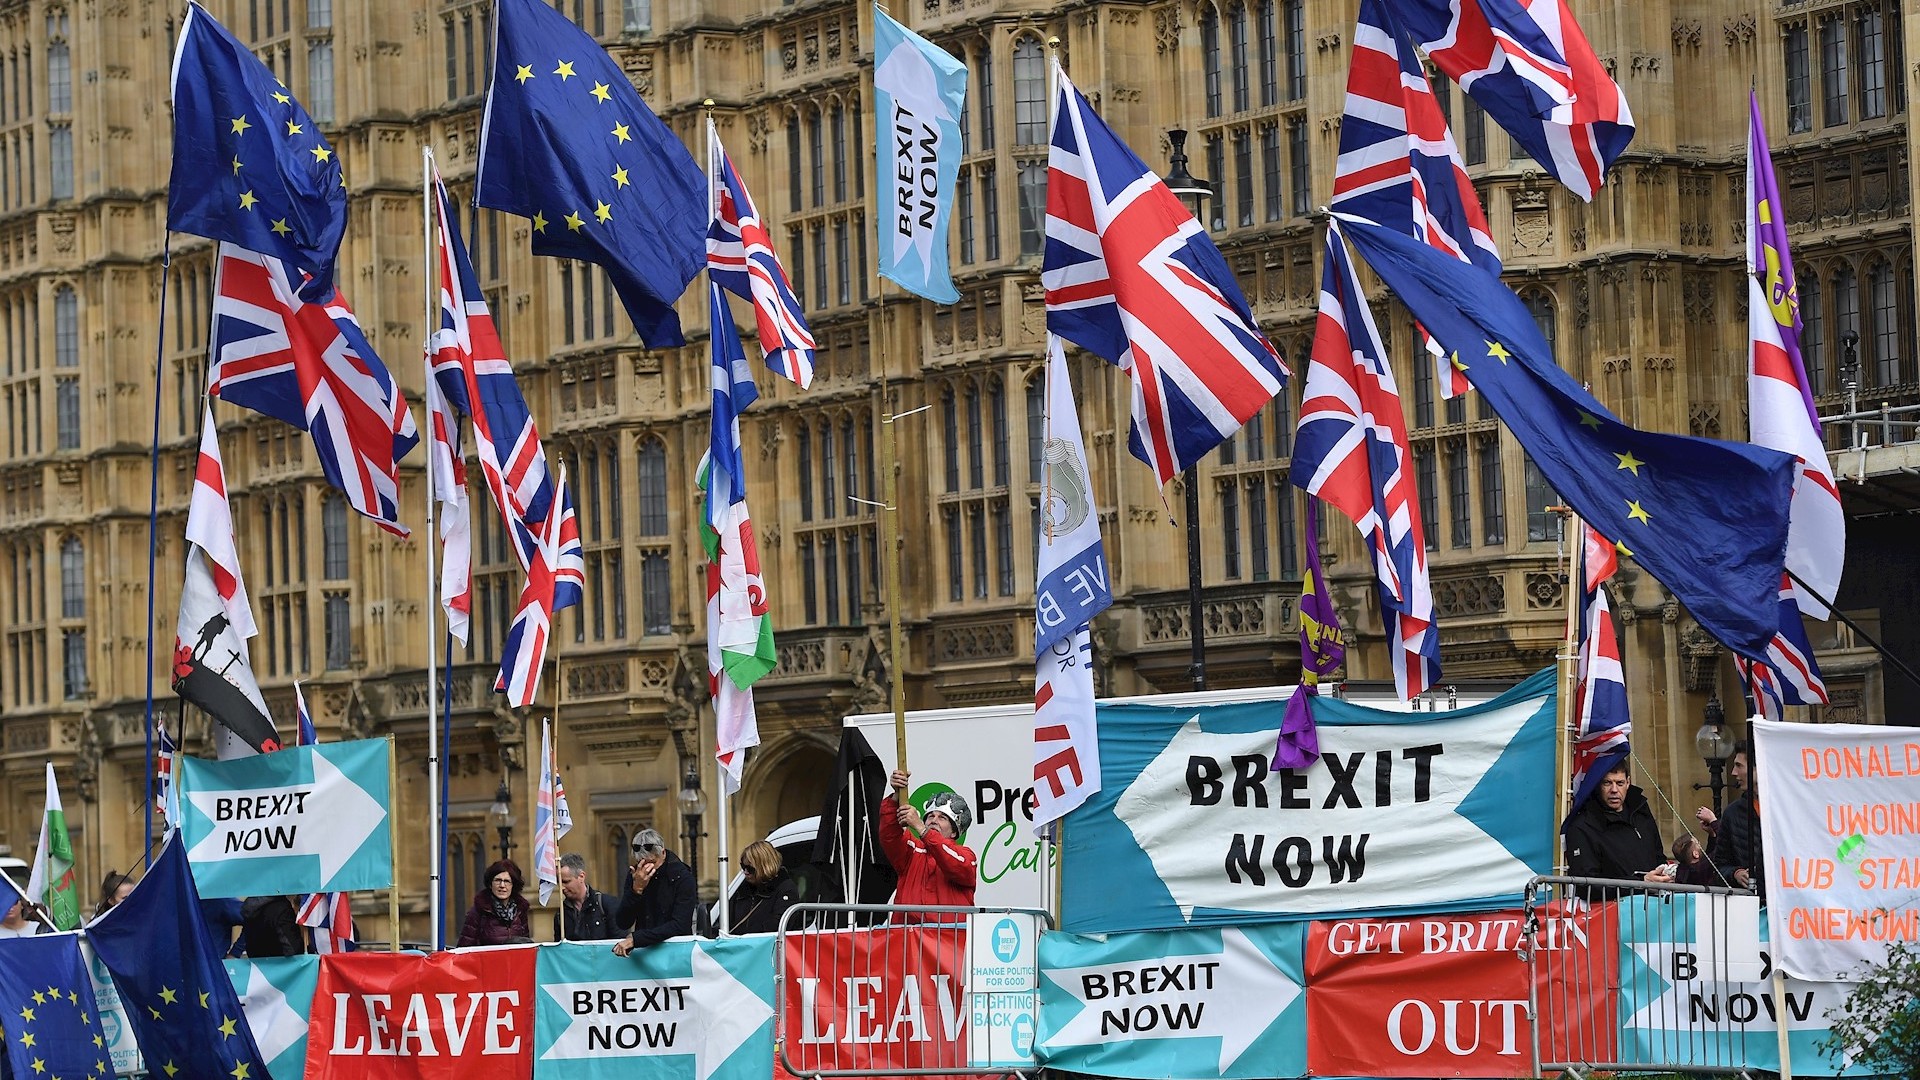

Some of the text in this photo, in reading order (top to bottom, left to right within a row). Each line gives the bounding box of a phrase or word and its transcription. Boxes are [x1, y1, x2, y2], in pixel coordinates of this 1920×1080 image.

[895, 98, 915, 238] BREXIT
[918, 122, 938, 230] NOW
[1185, 743, 1444, 810] BREXIT
[1802, 743, 1920, 779] DONALD
[216, 791, 312, 822] BREXIT
[224, 825, 297, 854] NOW
[1225, 833, 1371, 888] NOW
[1781, 857, 1834, 889] LUB
[1328, 916, 1592, 956] GET BRITAIN
[971, 966, 1036, 976] CHANGE POLITICS
[986, 977, 1025, 986] FOR GOOD
[1082, 962, 1220, 1000] BREXIT
[572, 984, 691, 1016] BREXIT
[796, 974, 968, 1044] LEAV
[974, 995, 1033, 1010] FIGHTING
[1689, 991, 1815, 1023] NOW
[328, 989, 522, 1057] LEAVE
[587, 1021, 678, 1052] NOW
[974, 1012, 1013, 1027] BACK
[1100, 1002, 1205, 1037] NOW
[1386, 999, 1531, 1056] OUT
